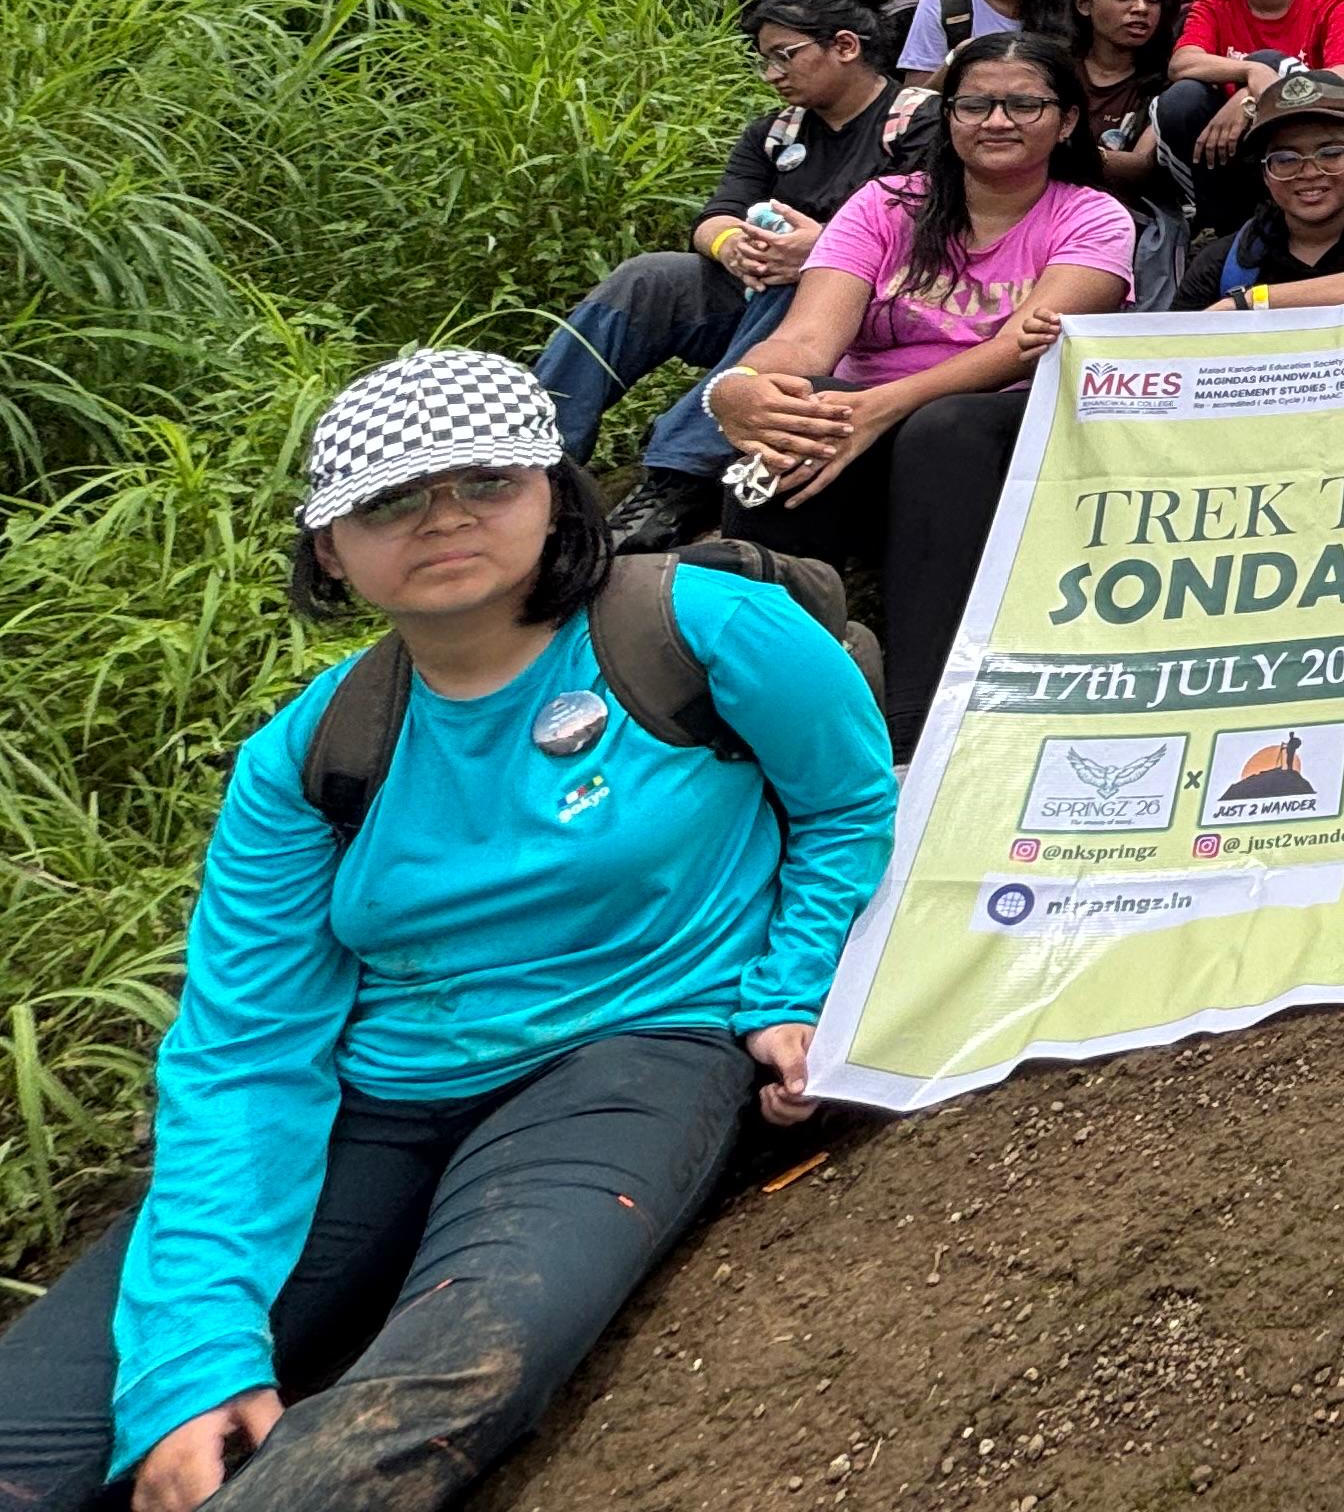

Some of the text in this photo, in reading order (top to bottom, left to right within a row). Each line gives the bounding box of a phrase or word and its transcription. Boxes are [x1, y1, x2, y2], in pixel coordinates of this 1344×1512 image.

[1268, 362, 1312, 372] Education
[1082, 372, 1182, 396] MKES
[1196, 376, 1257, 386] NAGINDAS
[1259, 371, 1331, 383] KHANDWALA
[1194, 388, 1276, 400] MANAGEMENT
[1279, 383, 1327, 395] STUDIES
[1076, 480, 1296, 549] TREK
[1026, 660, 1137, 700] 17th
[1146, 651, 1289, 708] JULY
[1213, 798, 1317, 819] JUST 2 WANDER
[1042, 844, 1158, 864] @nkspringz
